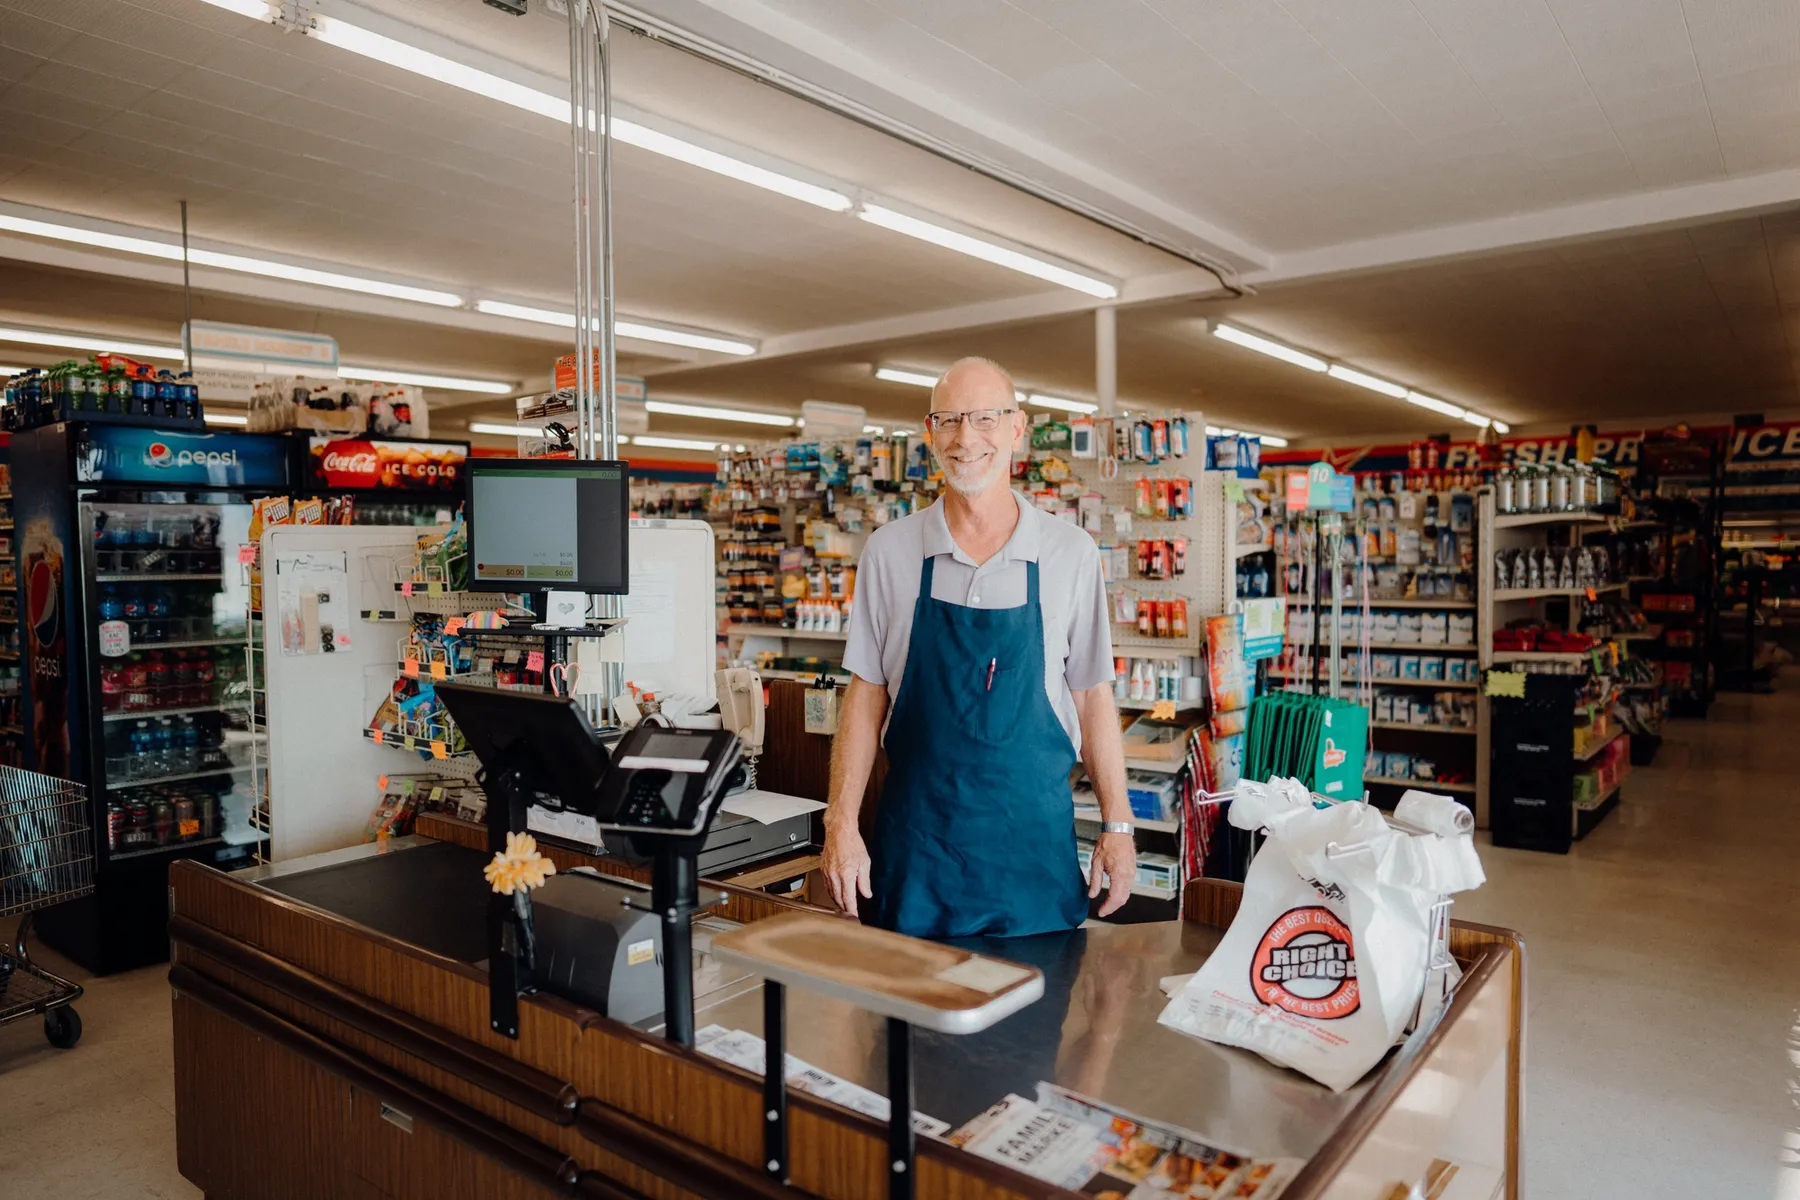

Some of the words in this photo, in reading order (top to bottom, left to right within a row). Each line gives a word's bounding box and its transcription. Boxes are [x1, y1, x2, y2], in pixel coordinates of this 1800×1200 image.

[178, 449, 237, 468] pepsi
[386, 463, 410, 475] ICE
[417, 464, 456, 477] COLD
[34, 654, 60, 681] pepsi
[1269, 923, 1287, 943] THE
[1284, 912, 1312, 929] BEST
[1271, 943, 1348, 966] RIGHT
[1263, 959, 1357, 981] CHOICE
[1301, 1002, 1331, 1013] BEST
